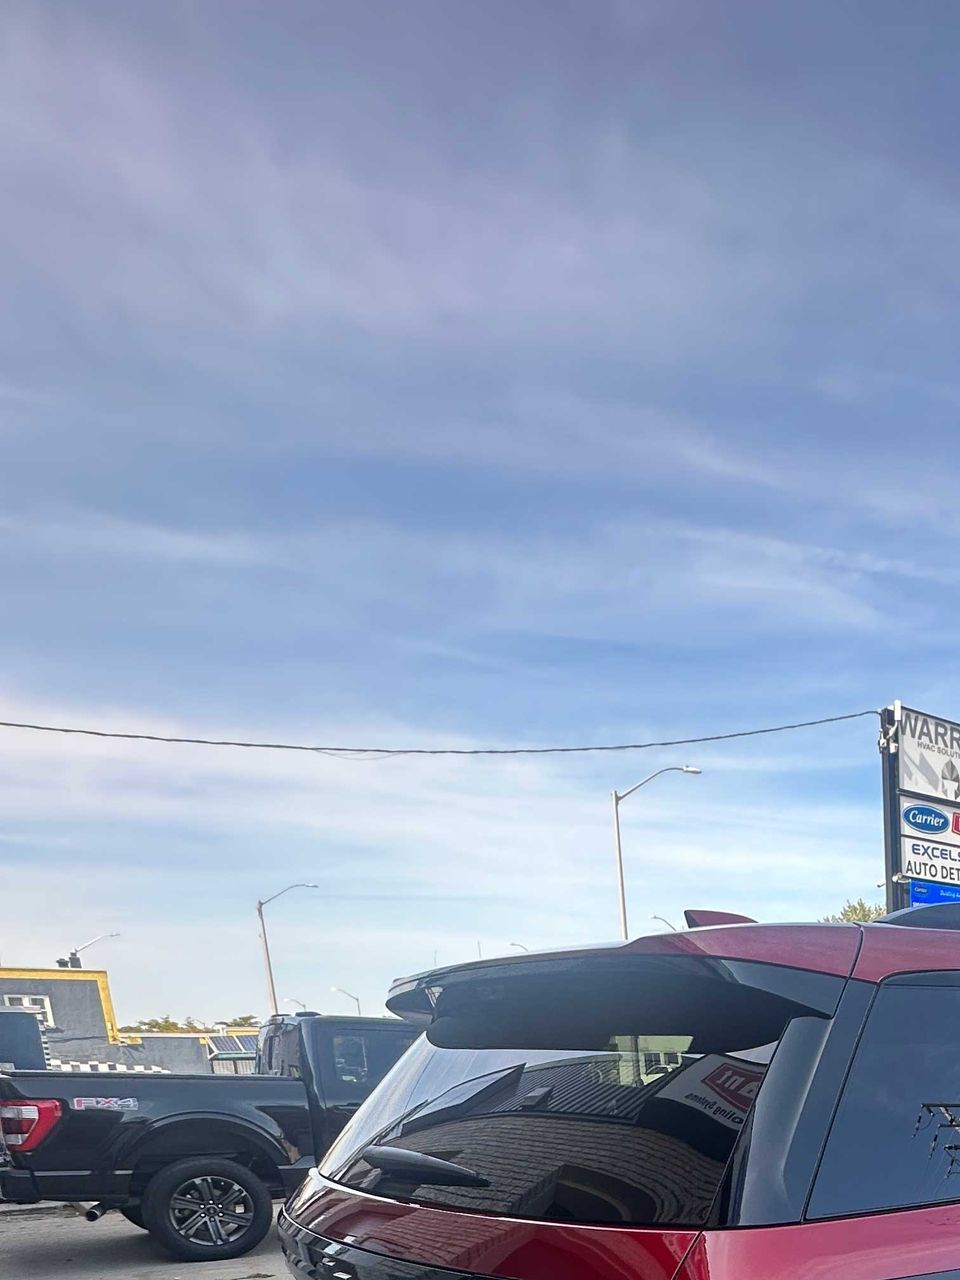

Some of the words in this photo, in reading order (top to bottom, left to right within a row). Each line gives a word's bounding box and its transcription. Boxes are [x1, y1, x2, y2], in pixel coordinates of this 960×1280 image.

[917, 740, 936, 753] HVAC
[909, 810, 944, 827] Carrier
[906, 860, 938, 878] AUTO
[73, 1097, 138, 1110] FX4
